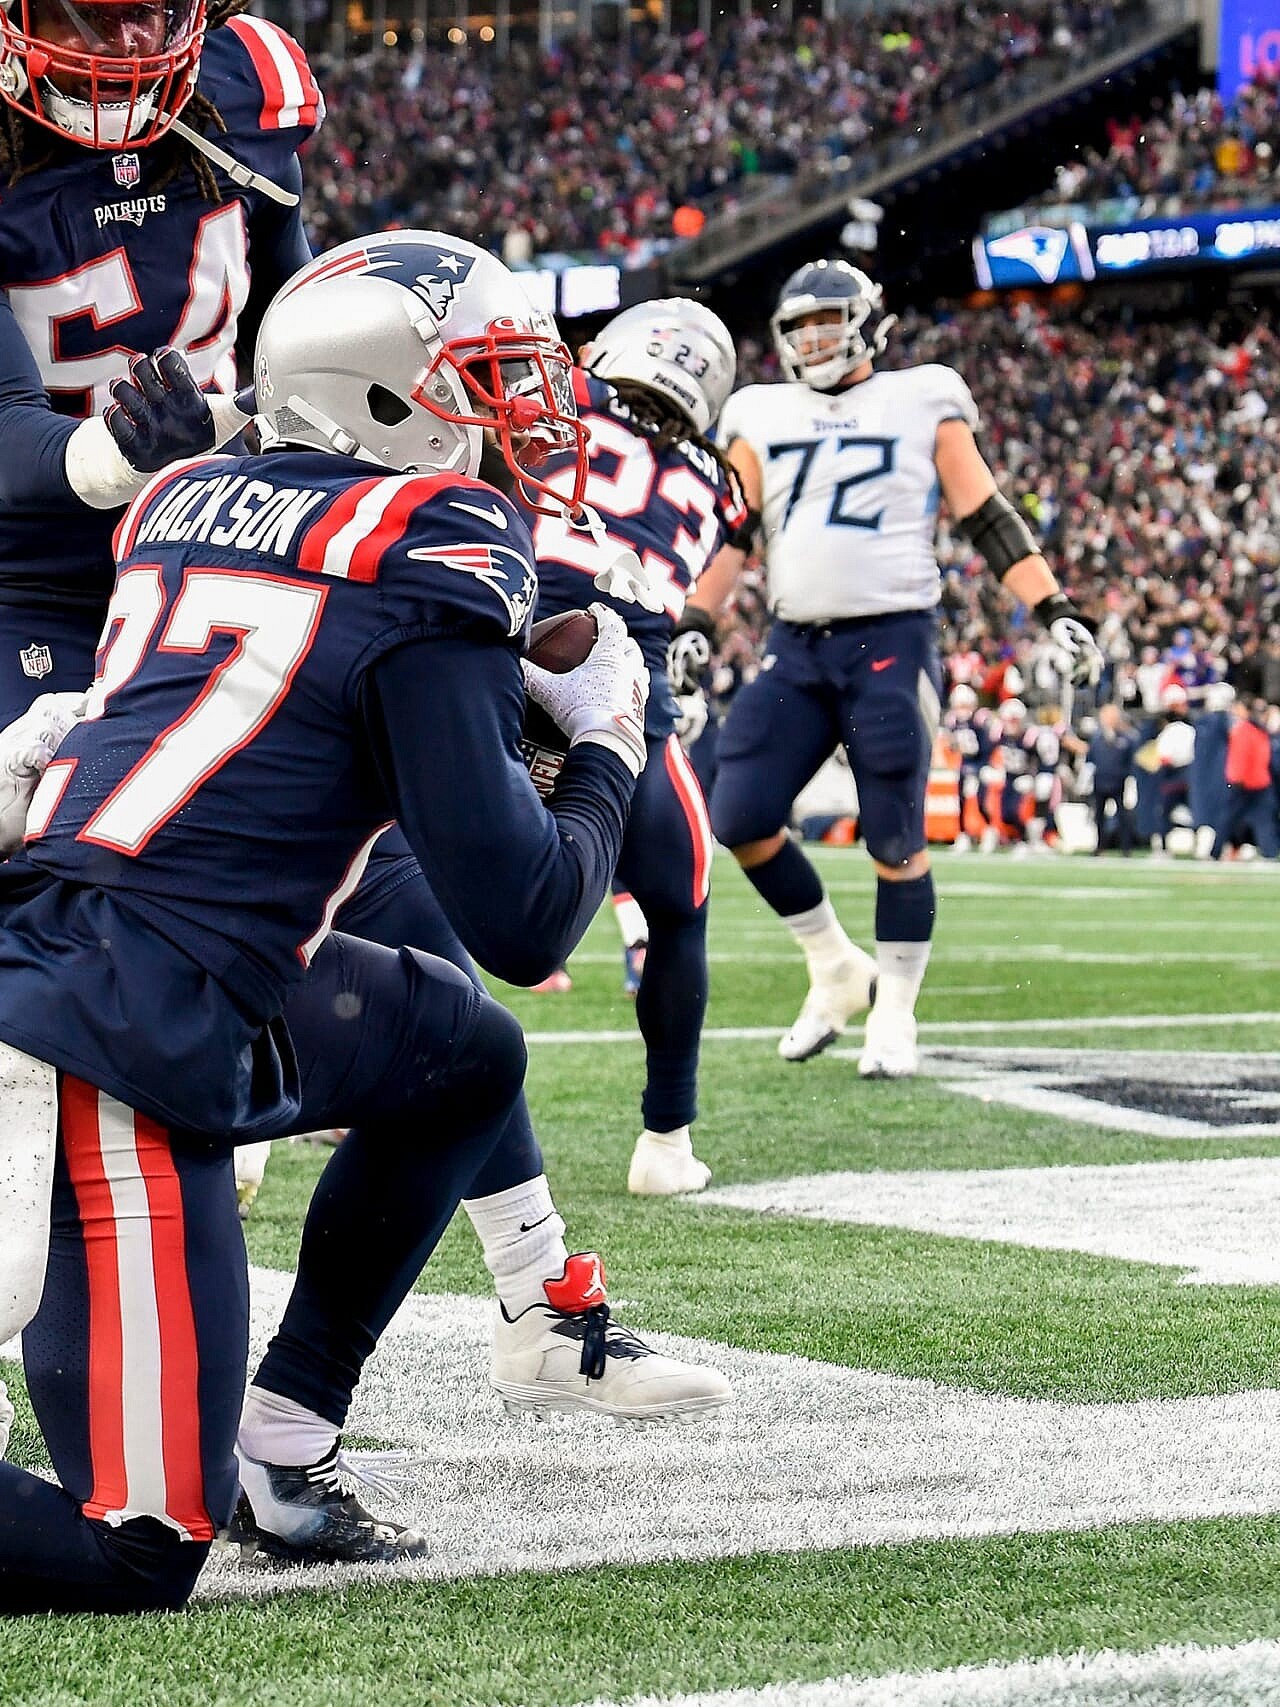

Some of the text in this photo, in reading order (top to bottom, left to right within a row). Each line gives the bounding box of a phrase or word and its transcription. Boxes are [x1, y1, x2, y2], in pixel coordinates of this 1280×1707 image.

[94, 194, 166, 229] PATRIOTS
[2, 200, 251, 418] 54
[674, 344, 709, 378] 23
[135, 474, 328, 557] JACKSON
[533, 411, 720, 625] 23
[767, 436, 902, 531] 72
[23, 563, 331, 857] 27
